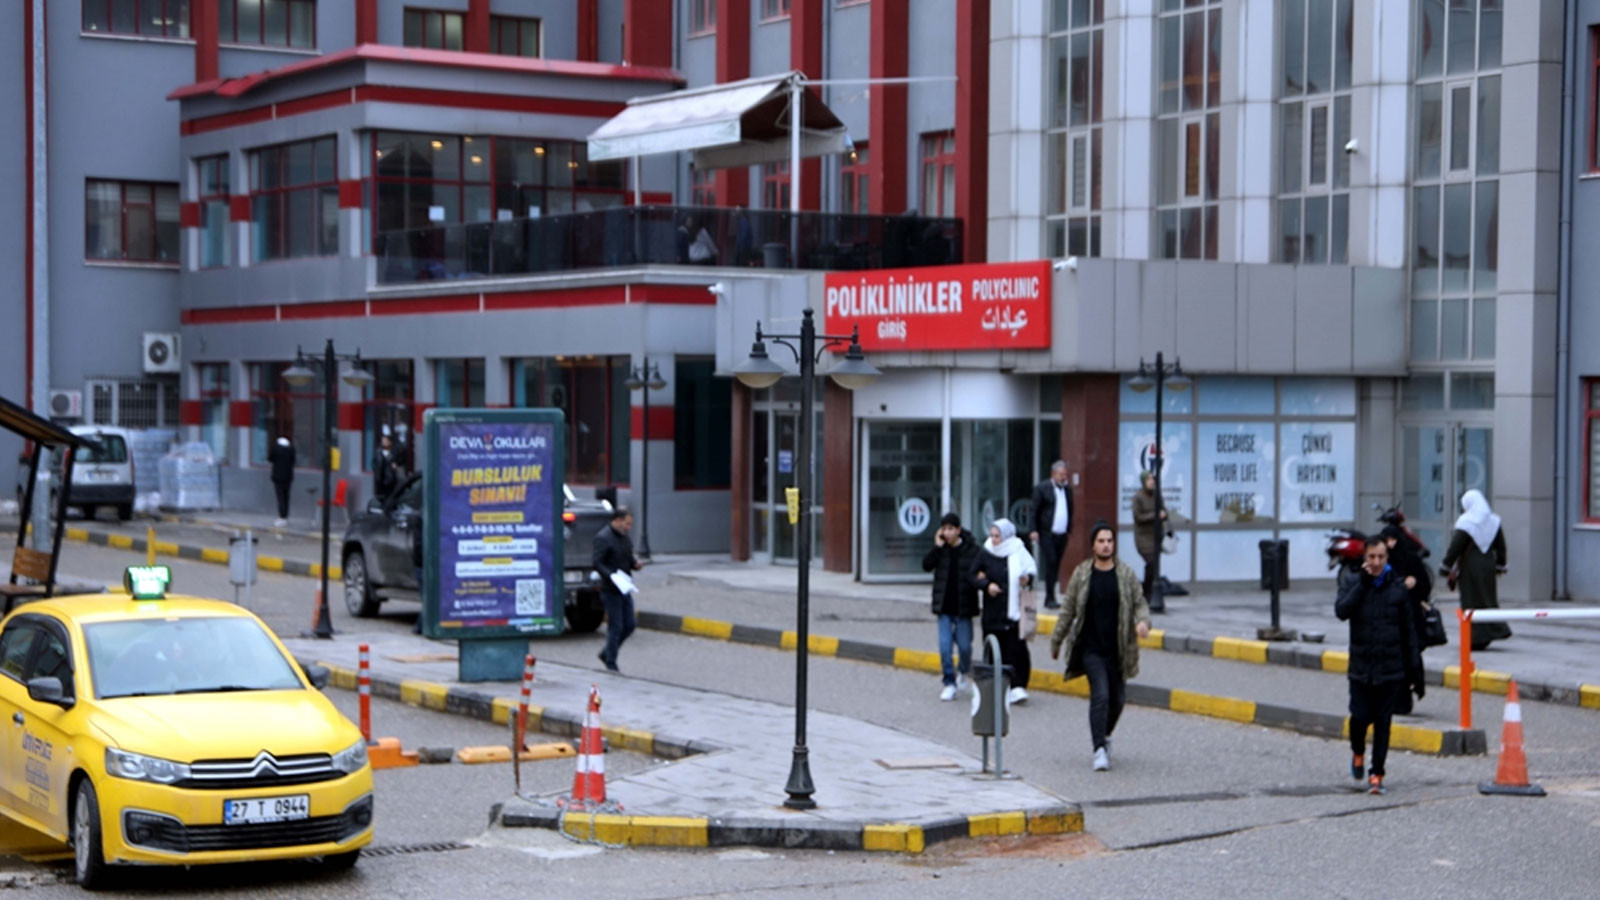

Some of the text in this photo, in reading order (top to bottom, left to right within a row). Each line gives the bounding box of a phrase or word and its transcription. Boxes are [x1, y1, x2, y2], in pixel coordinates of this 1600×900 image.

[827, 275, 962, 317] POLİKLİNİKLER
[972, 276, 1040, 300] POLYCLINIC
[877, 317, 907, 342] GİRİŞ
[981, 304, 1028, 337] عيادات
[449, 435, 546, 449] DEVA OKULLARI
[1216, 433, 1256, 453] BECAUSE
[1302, 432, 1332, 456] ÇÜNKÜ
[451, 464, 542, 487] BURSLULUK
[1213, 463, 1258, 483] YOUR LIFE
[1297, 464, 1337, 484] HAYATIN
[1300, 493, 1334, 514] ÖNEMLİ
[232, 798, 307, 818] 27 T 0944
